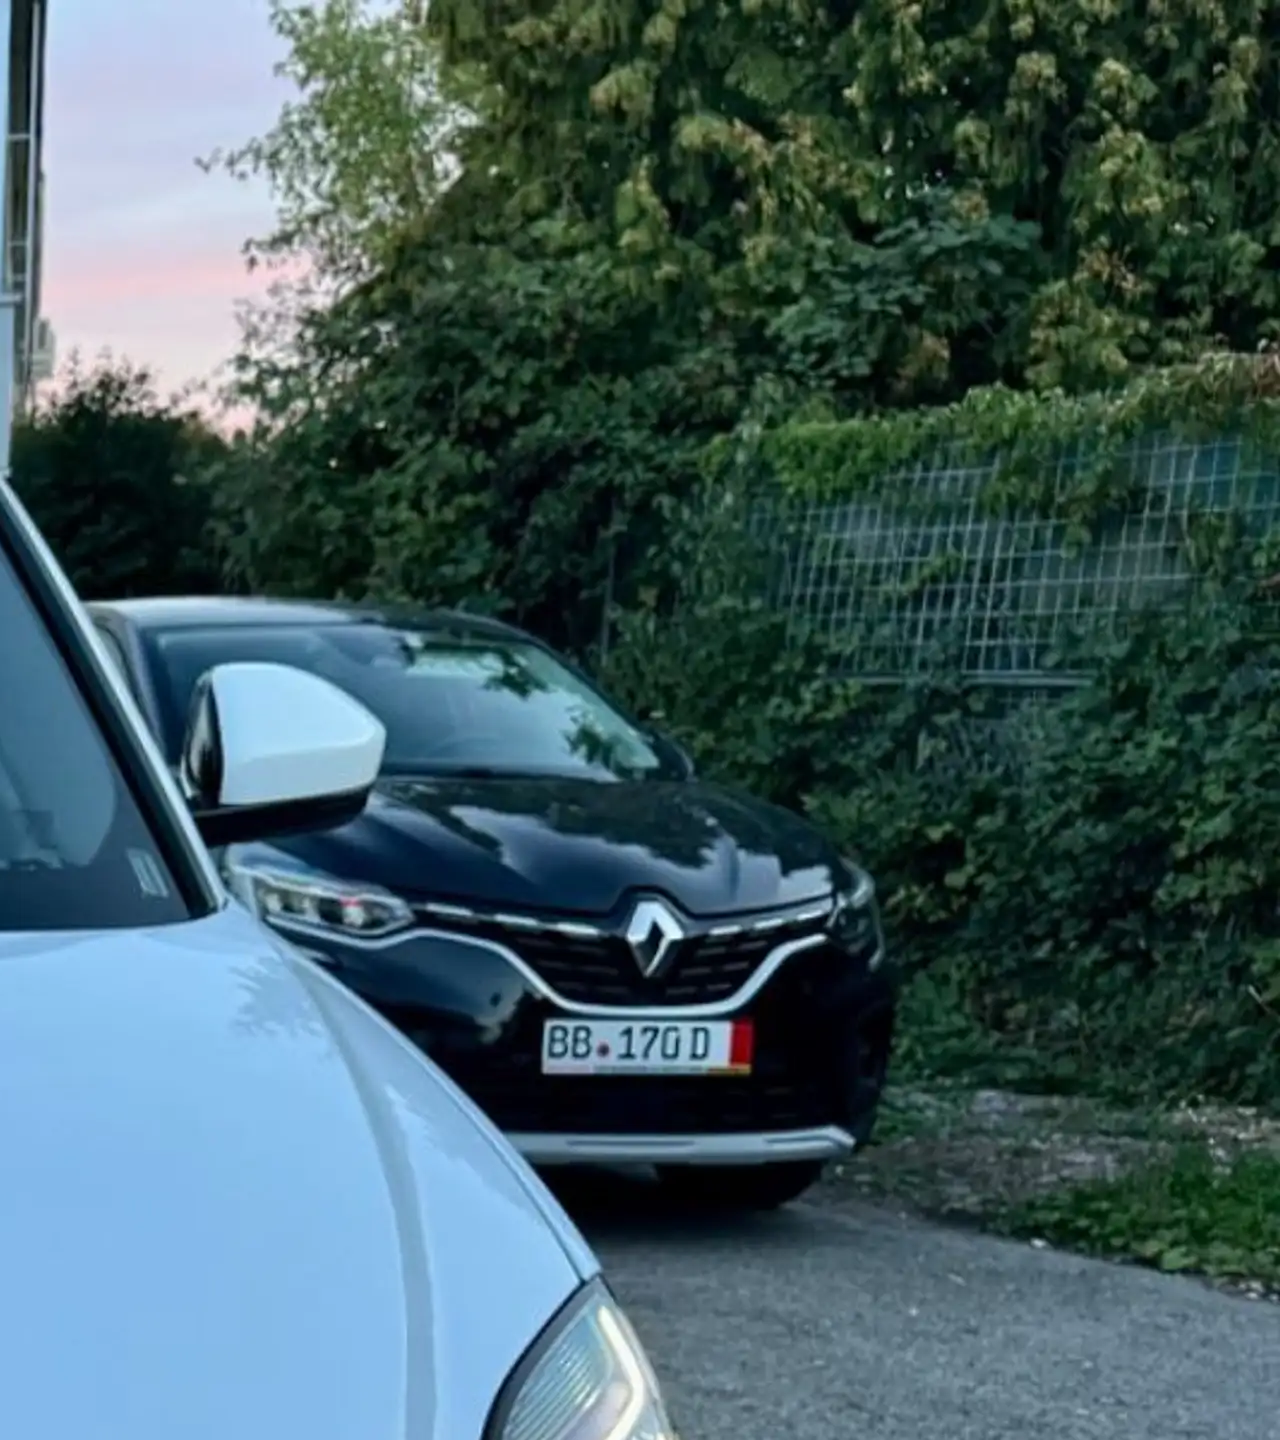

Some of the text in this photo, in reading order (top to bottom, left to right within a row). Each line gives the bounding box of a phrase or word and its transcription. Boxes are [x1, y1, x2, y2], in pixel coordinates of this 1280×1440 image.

[547, 1024, 711, 1061] BB 170 D
